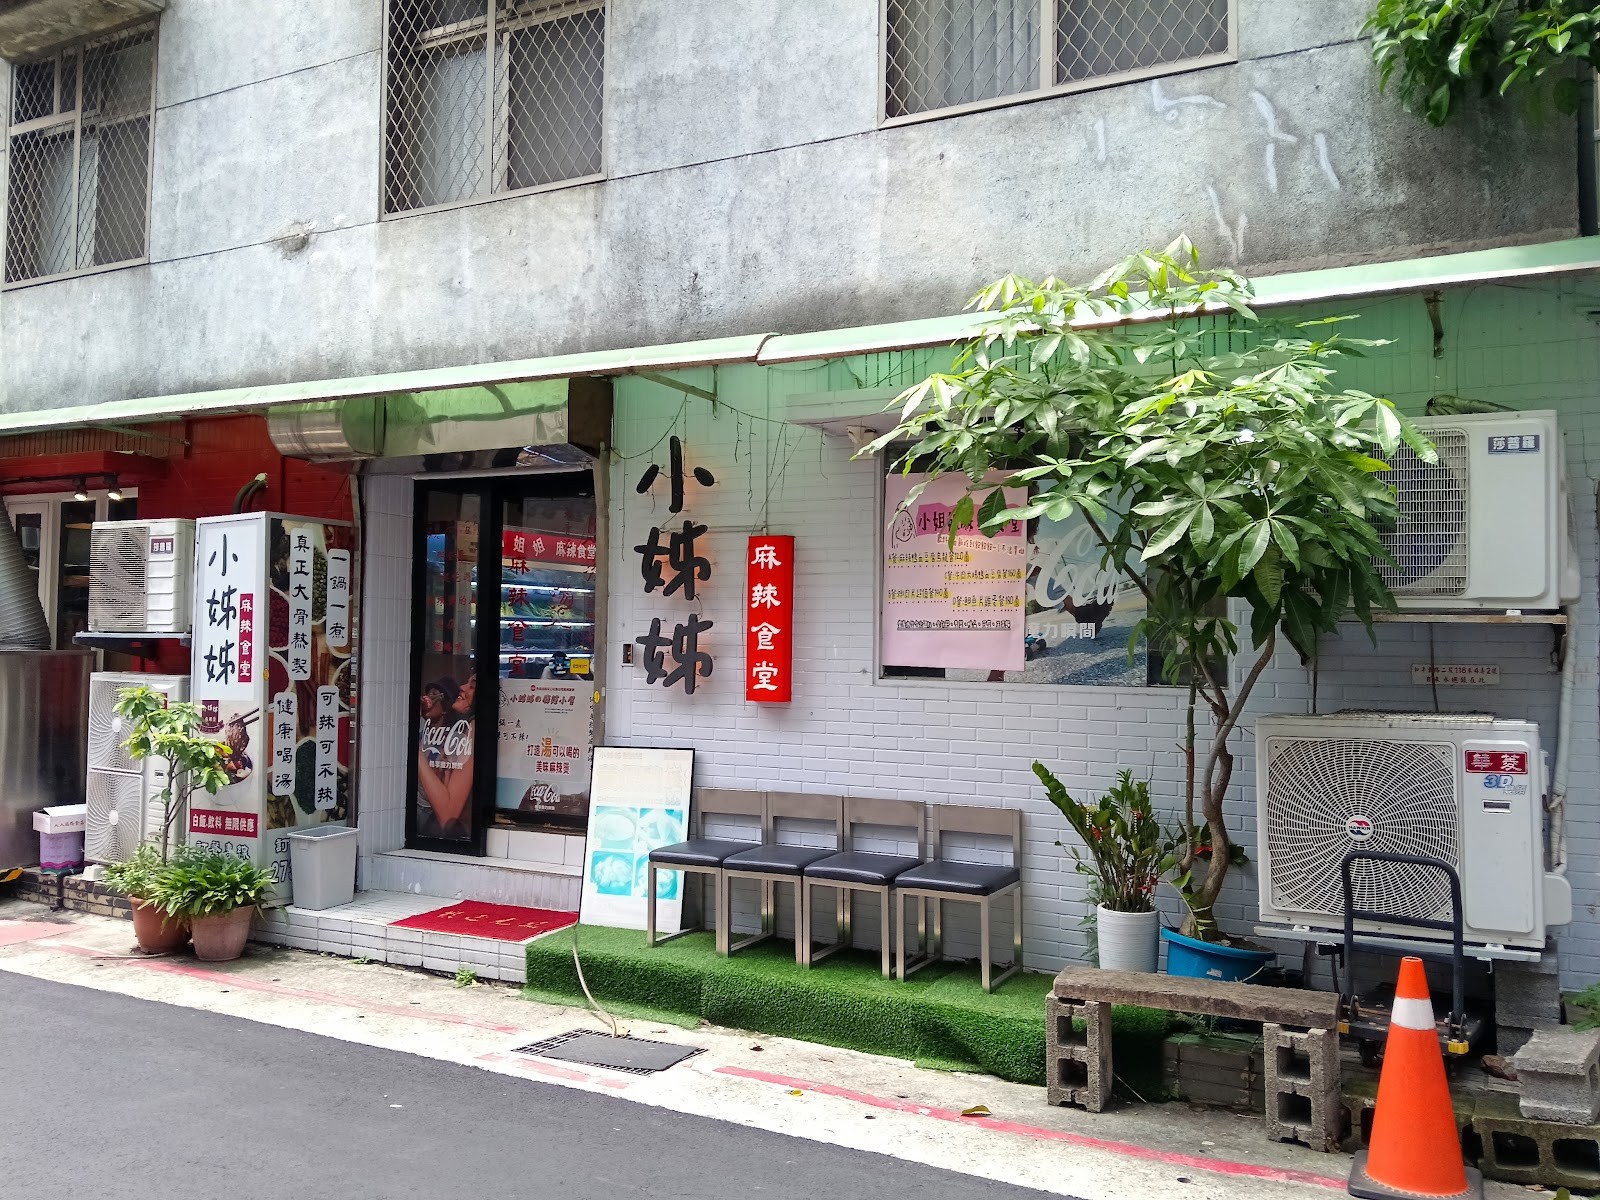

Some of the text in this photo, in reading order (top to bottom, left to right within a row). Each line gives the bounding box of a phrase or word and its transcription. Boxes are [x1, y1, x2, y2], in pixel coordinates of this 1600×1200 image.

[204, 533, 238, 685] 小姊姊
[291, 534, 311, 675] 真正大骨熬製
[328, 555, 348, 640] 一鍋一煮
[634, 435, 713, 695] 小姊姊
[240, 599, 253, 677] 麻辣食堂
[750, 543, 783, 692] 麻辣食堂
[275, 699, 295, 790] 健康喝湯
[317, 691, 337, 804] 可辣可不辣
[1471, 753, 1523, 772] 華菱
[1484, 774, 1514, 788] 3D
[271, 860, 293, 884] 27
